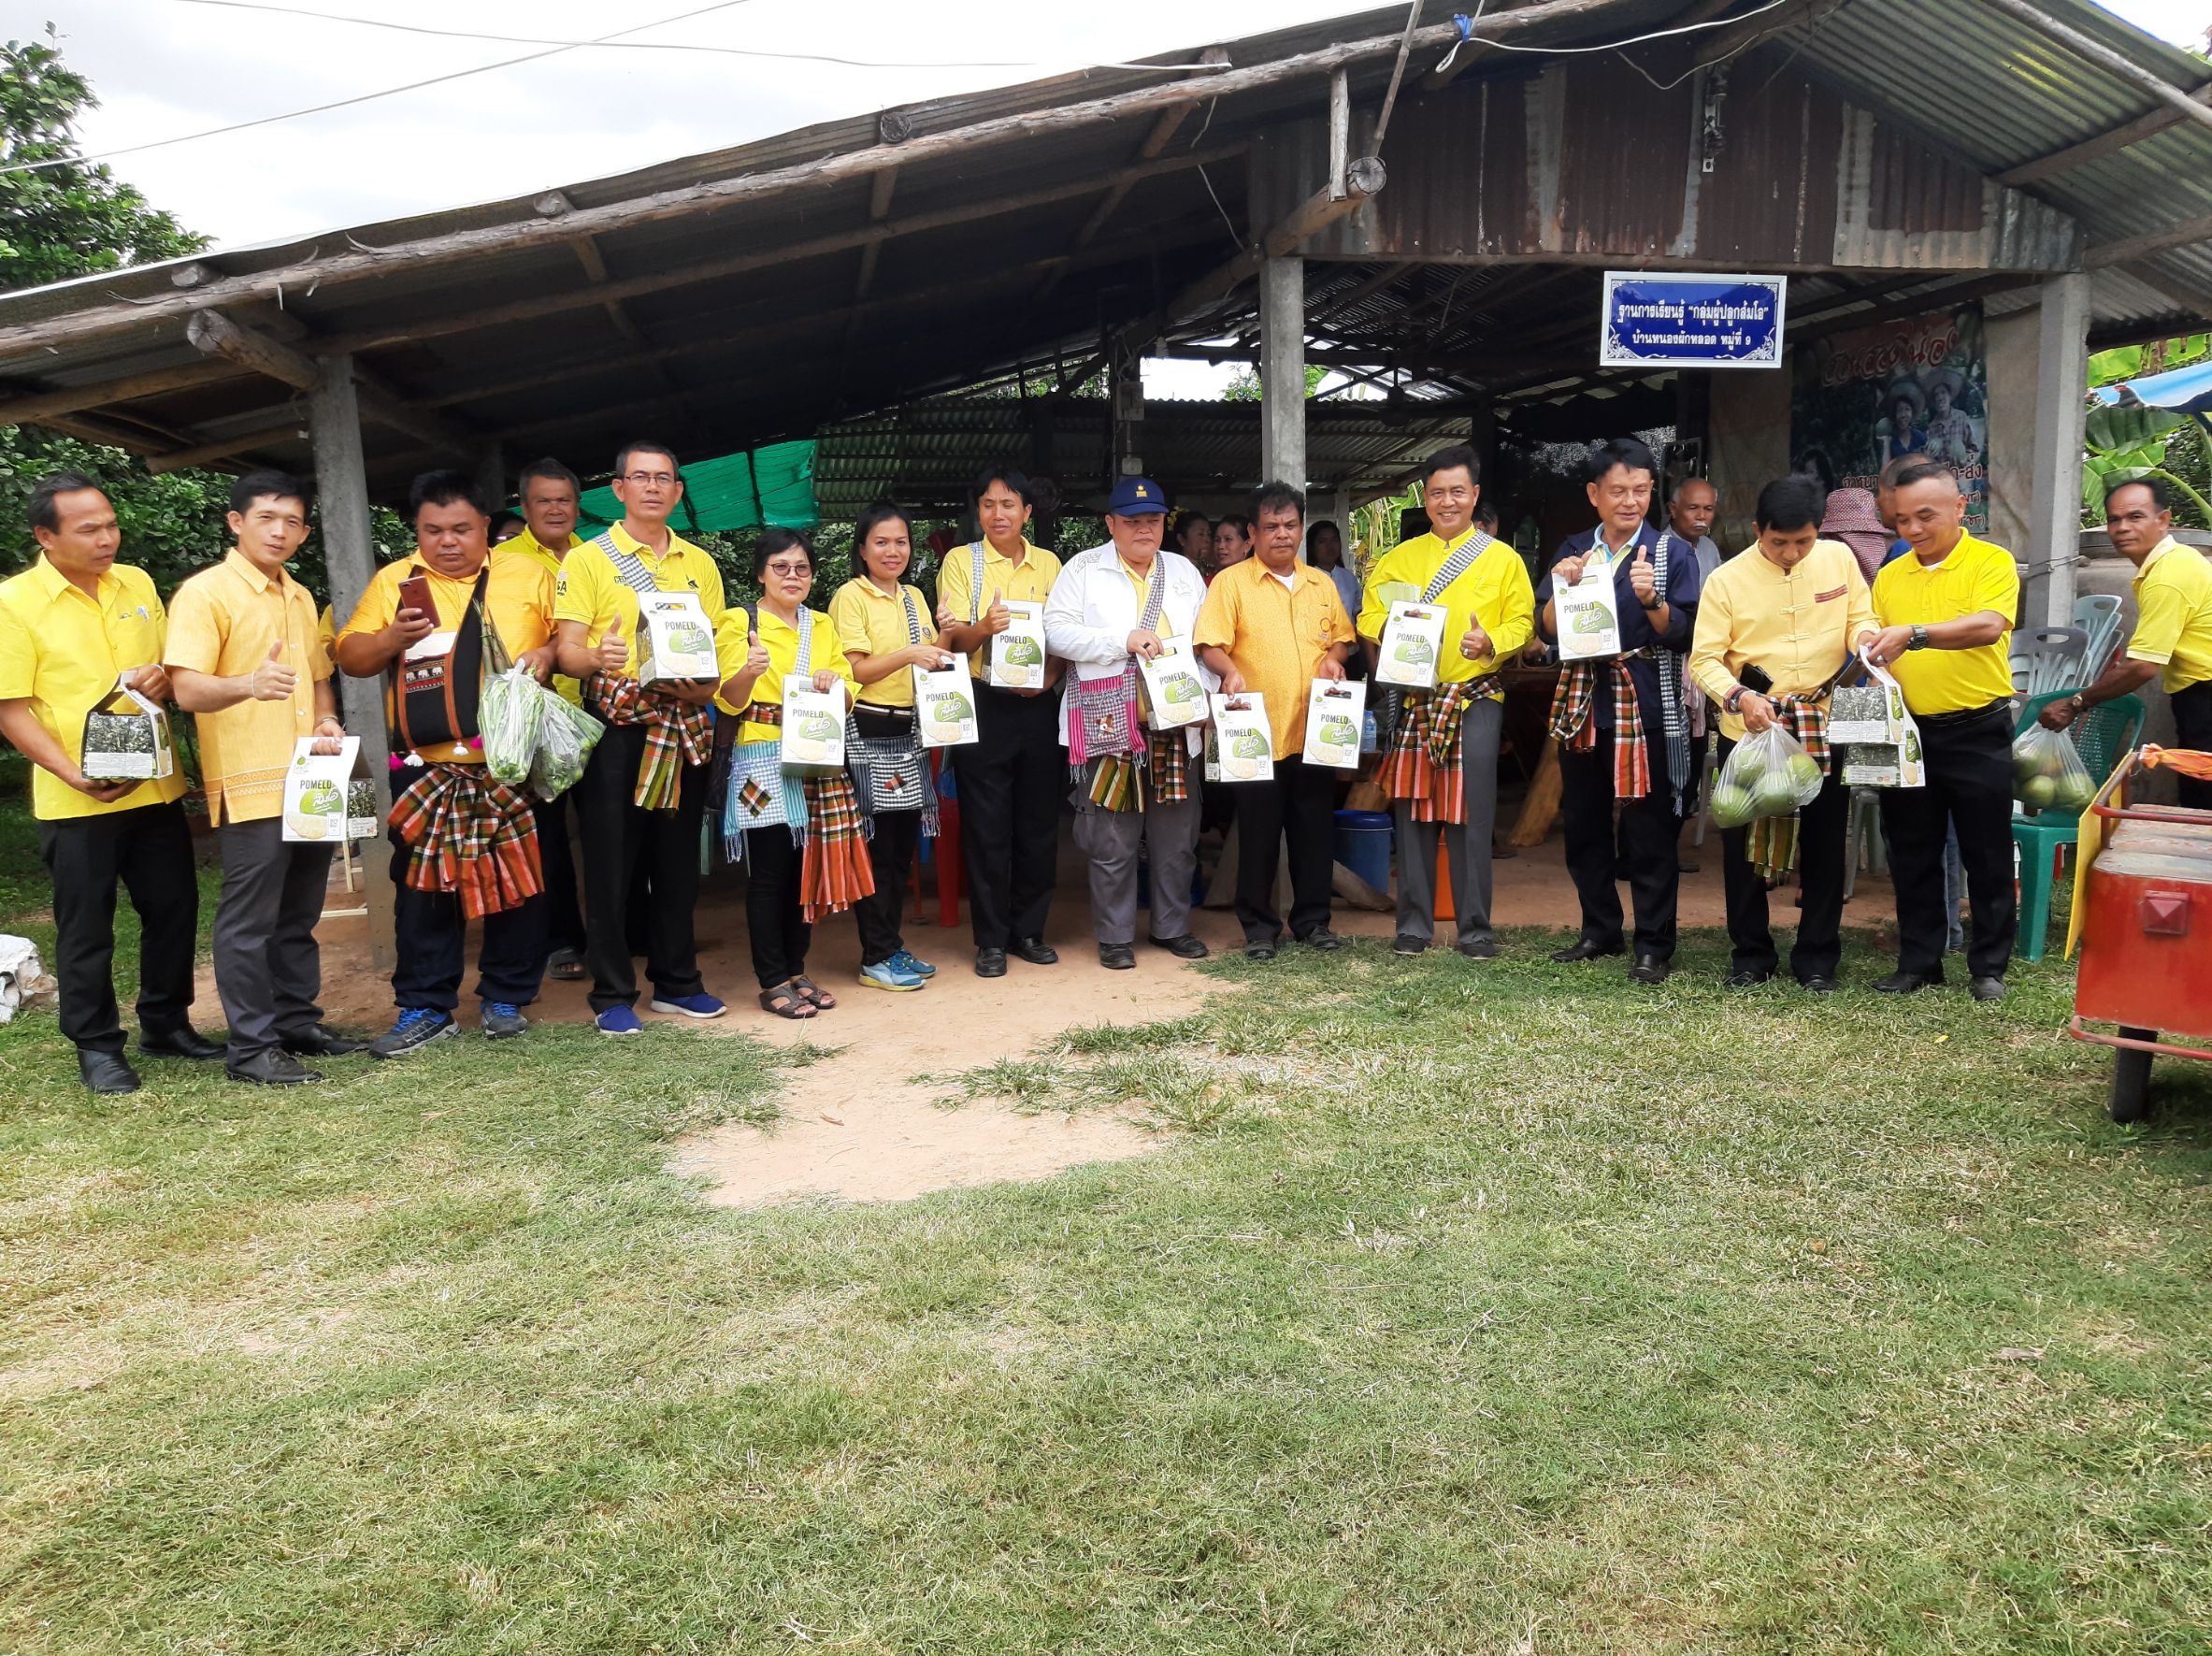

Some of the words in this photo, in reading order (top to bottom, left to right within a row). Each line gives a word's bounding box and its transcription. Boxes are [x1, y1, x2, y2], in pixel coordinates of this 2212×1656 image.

[1616, 298, 1685, 326] ฐานการเรียนรู้
[1632, 328, 1717, 345] บ้านหนองผักหลอด
[1720, 327, 1743, 351] หมู่ที่
[1745, 336, 1752, 346] 9
[1563, 601, 1595, 613] POMELO
[665, 621, 697, 631] POMELO
[999, 634, 1027, 644] POMELO
[1396, 632, 1426, 643] POMELO
[1159, 670, 1186, 685] POMELO
[926, 691, 955, 702] POMELO
[792, 708, 824, 719] POMELO
[1320, 713, 1349, 725] POMELO
[1225, 727, 1252, 738] POMELO
[299, 779, 333, 790] POMELO
